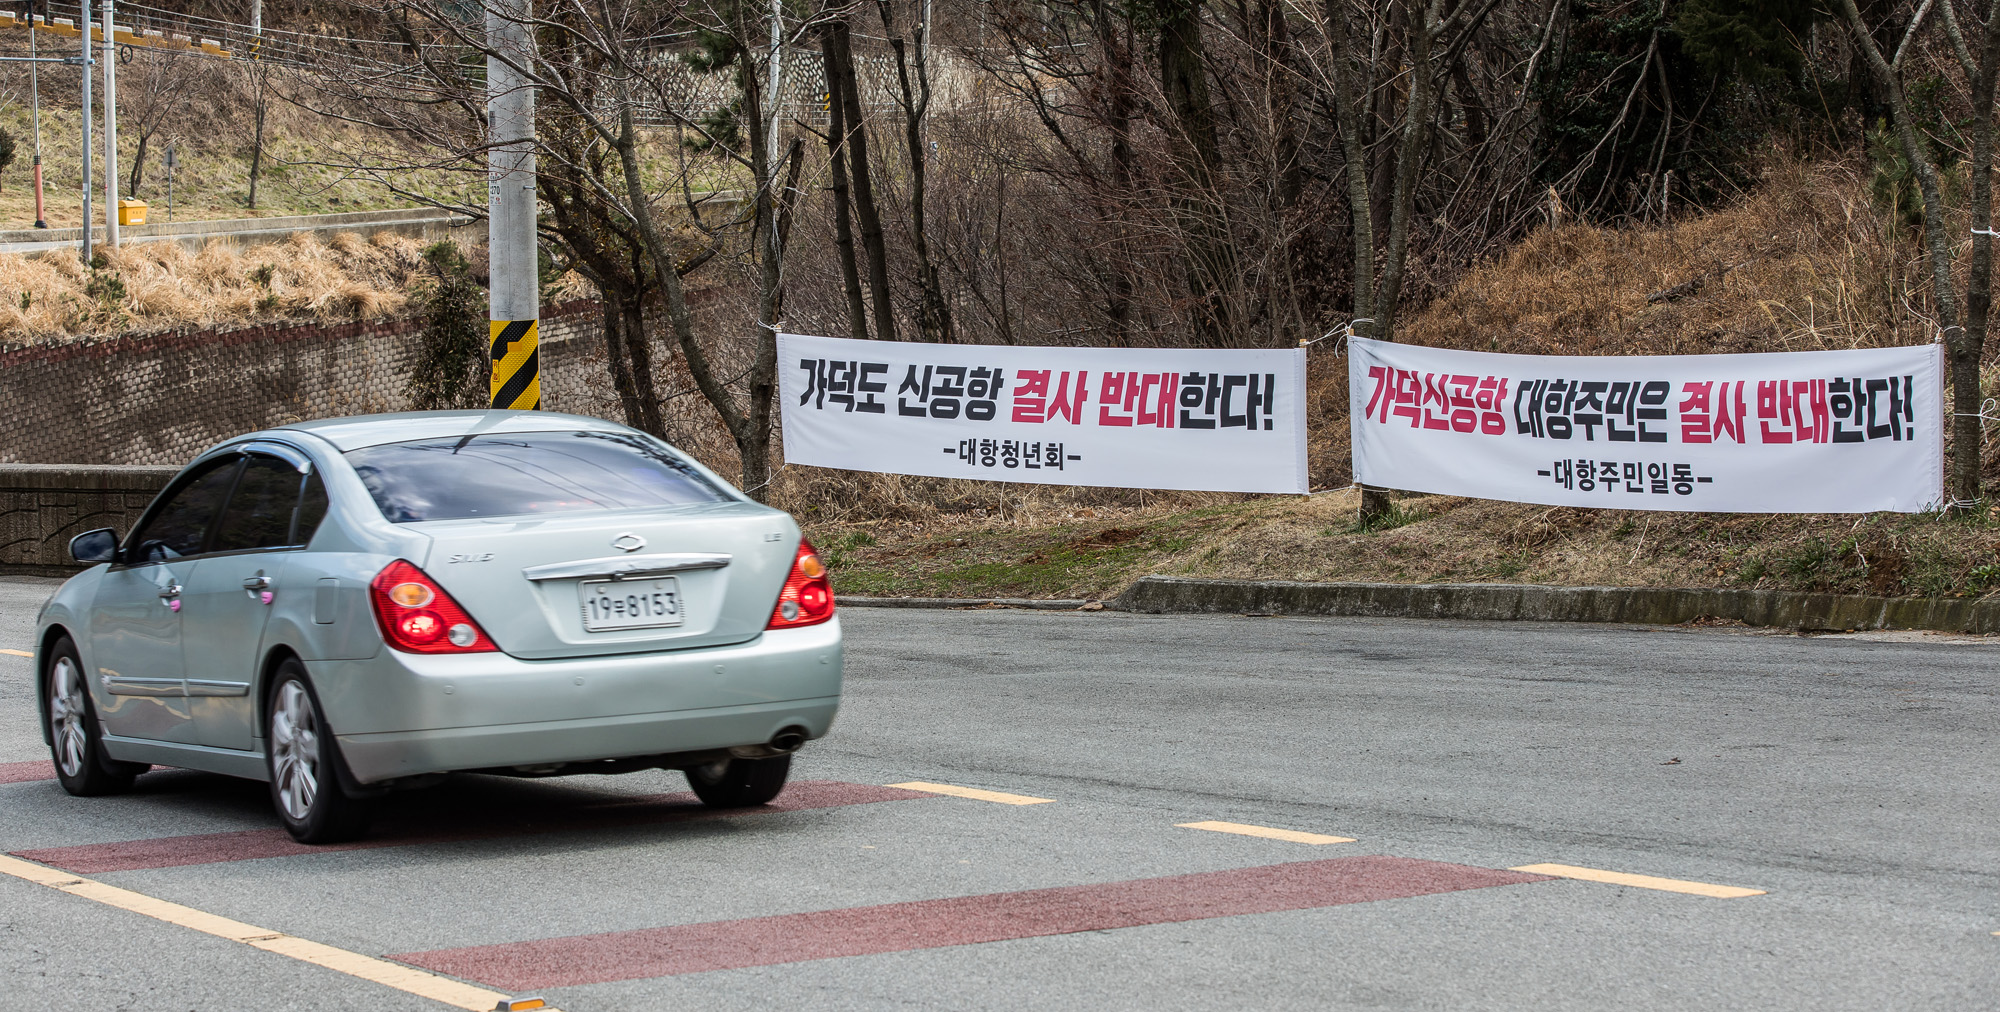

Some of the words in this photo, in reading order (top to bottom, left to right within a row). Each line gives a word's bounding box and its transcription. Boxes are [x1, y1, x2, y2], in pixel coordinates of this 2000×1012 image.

[799, 358, 889, 415] 가덕도
[897, 364, 1004, 422] 신공항
[1011, 368, 1089, 426] 결사
[1098, 371, 1275, 431] 반대한다!
[1364, 364, 1509, 436] 가덕신공항
[1513, 378, 1671, 444] 대항주민은
[1678, 379, 1747, 445] 결사
[1756, 374, 1915, 445] 반대한다!
